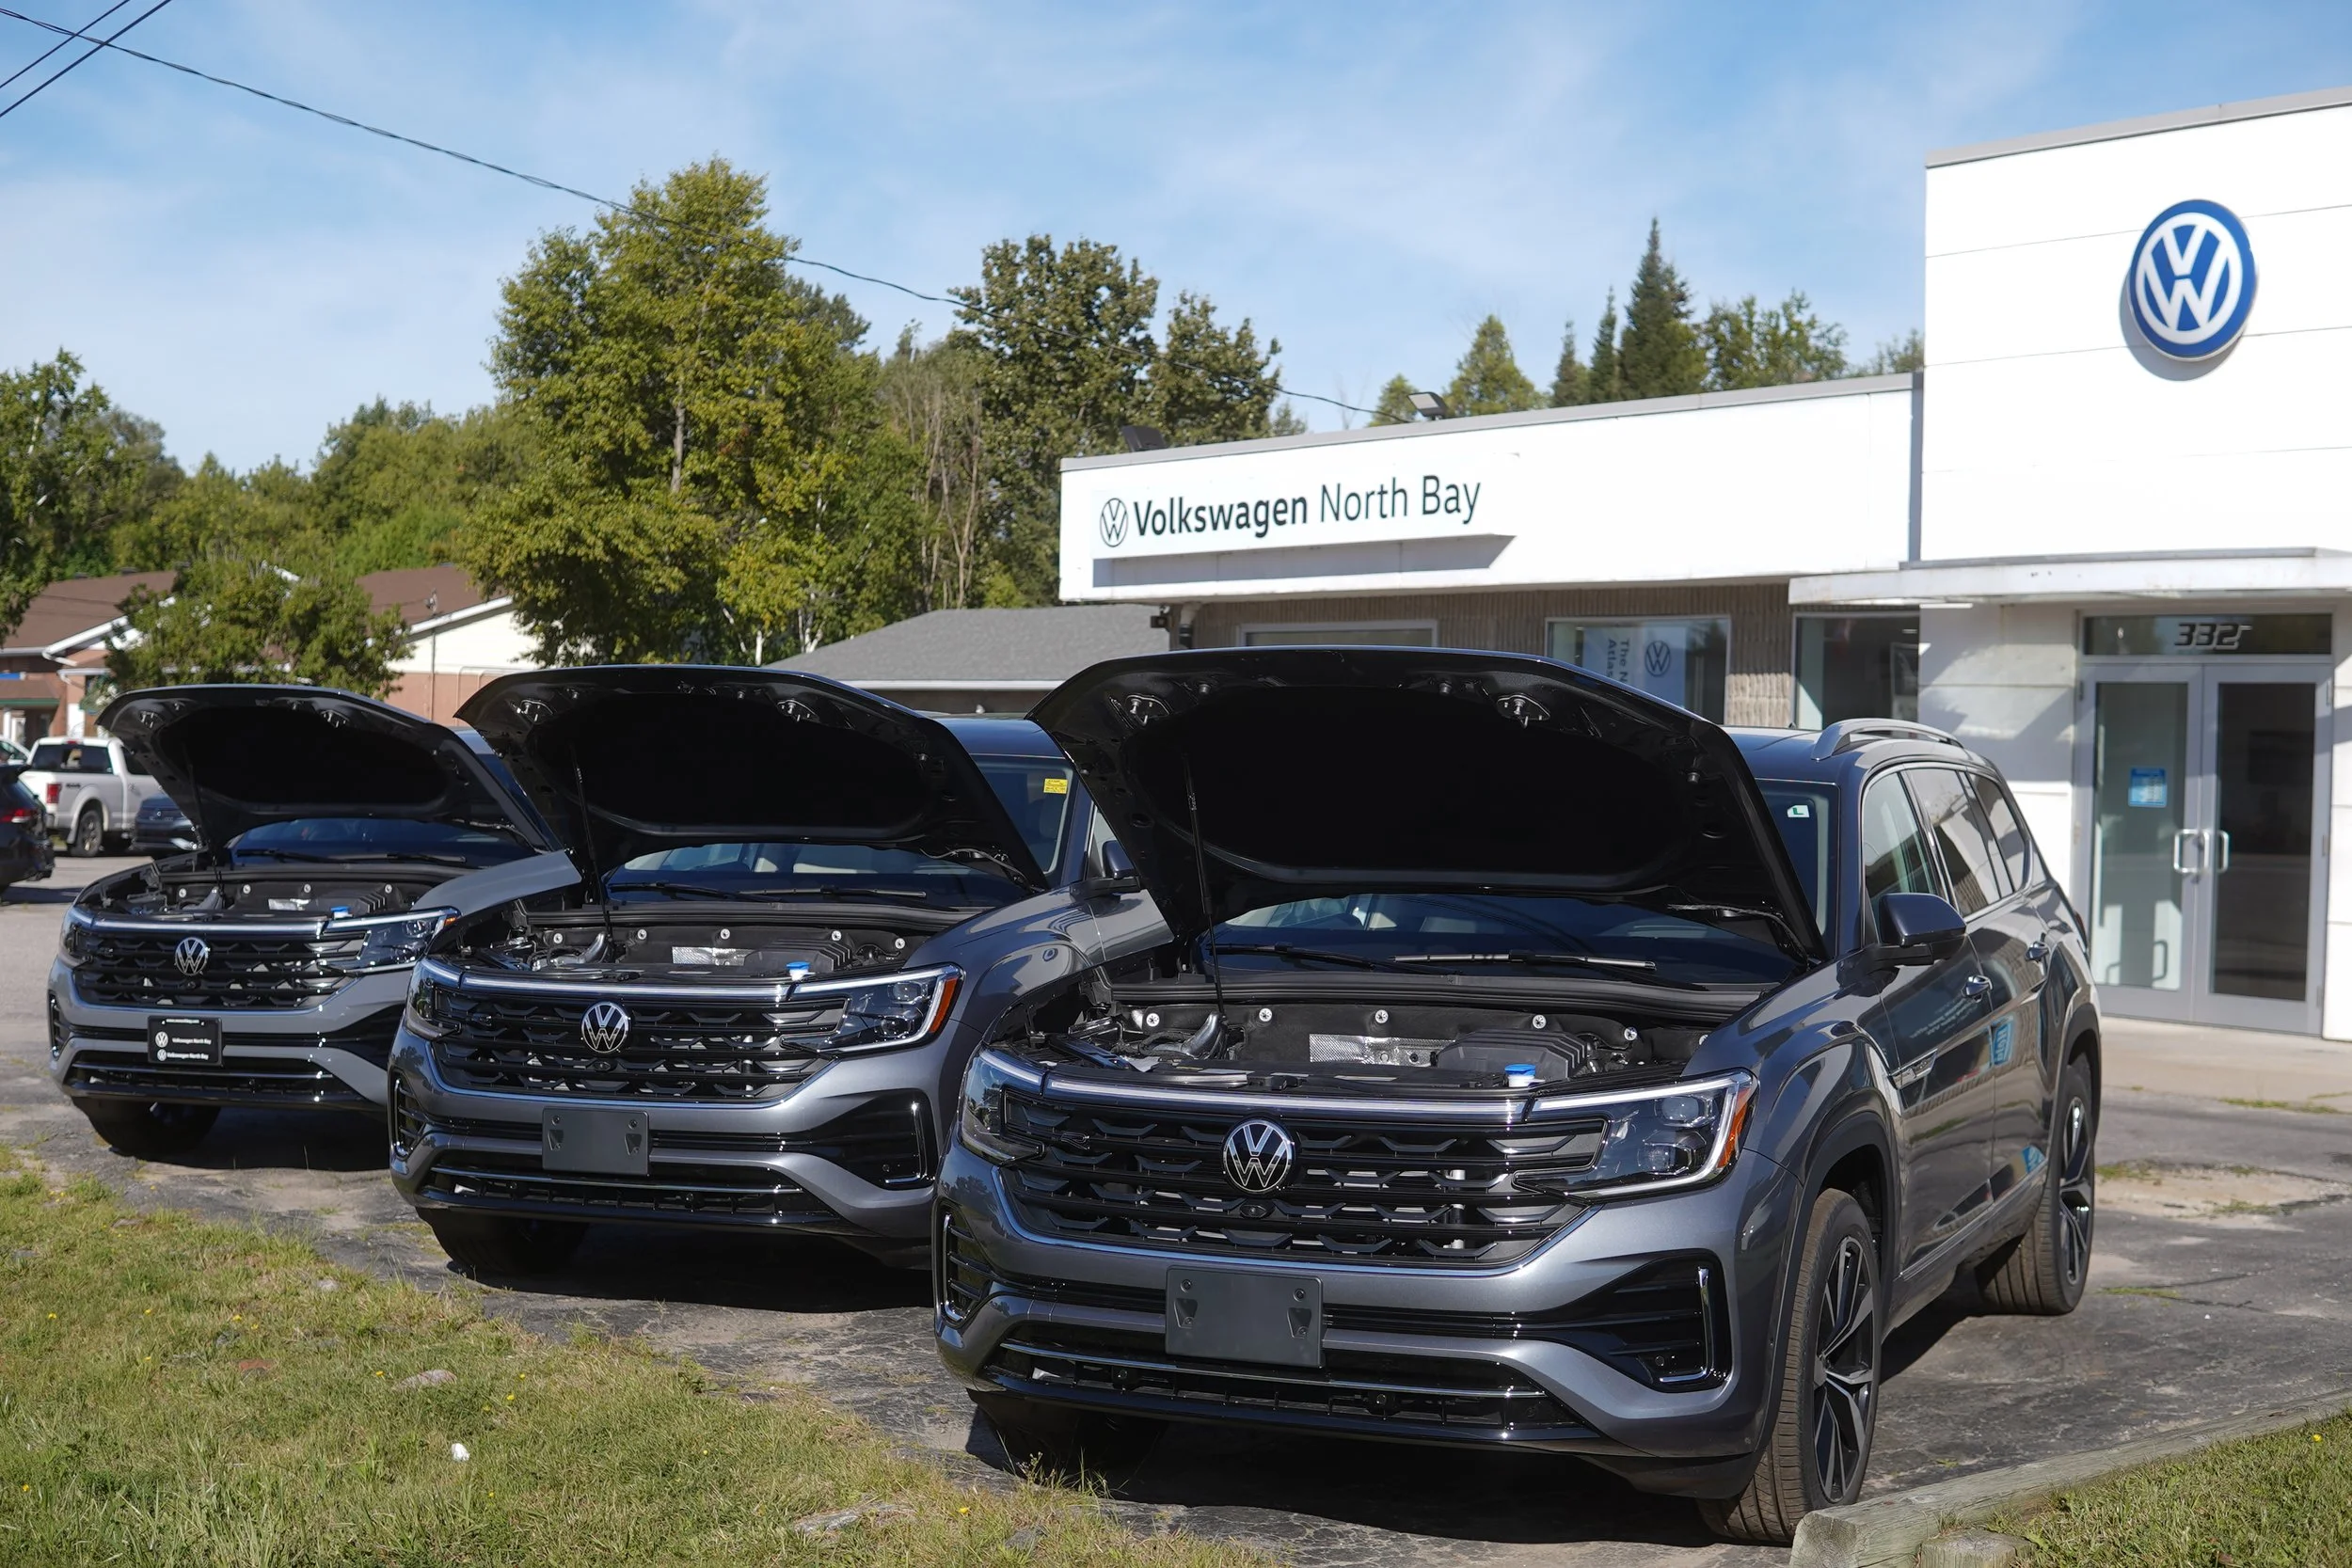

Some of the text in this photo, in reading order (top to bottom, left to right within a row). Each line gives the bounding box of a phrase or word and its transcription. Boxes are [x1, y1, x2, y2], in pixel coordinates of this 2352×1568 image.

[2135, 211, 2244, 345] VW
[1133, 495, 1309, 539] Volkswagen
[1320, 476, 1408, 523] North
[1421, 474, 1482, 525] Bay
[1606, 639, 1617, 677] Atlas
[1620, 640, 1629, 667] The
[581, 1001, 631, 1053] VW
[1223, 1119, 1295, 1195] VW
